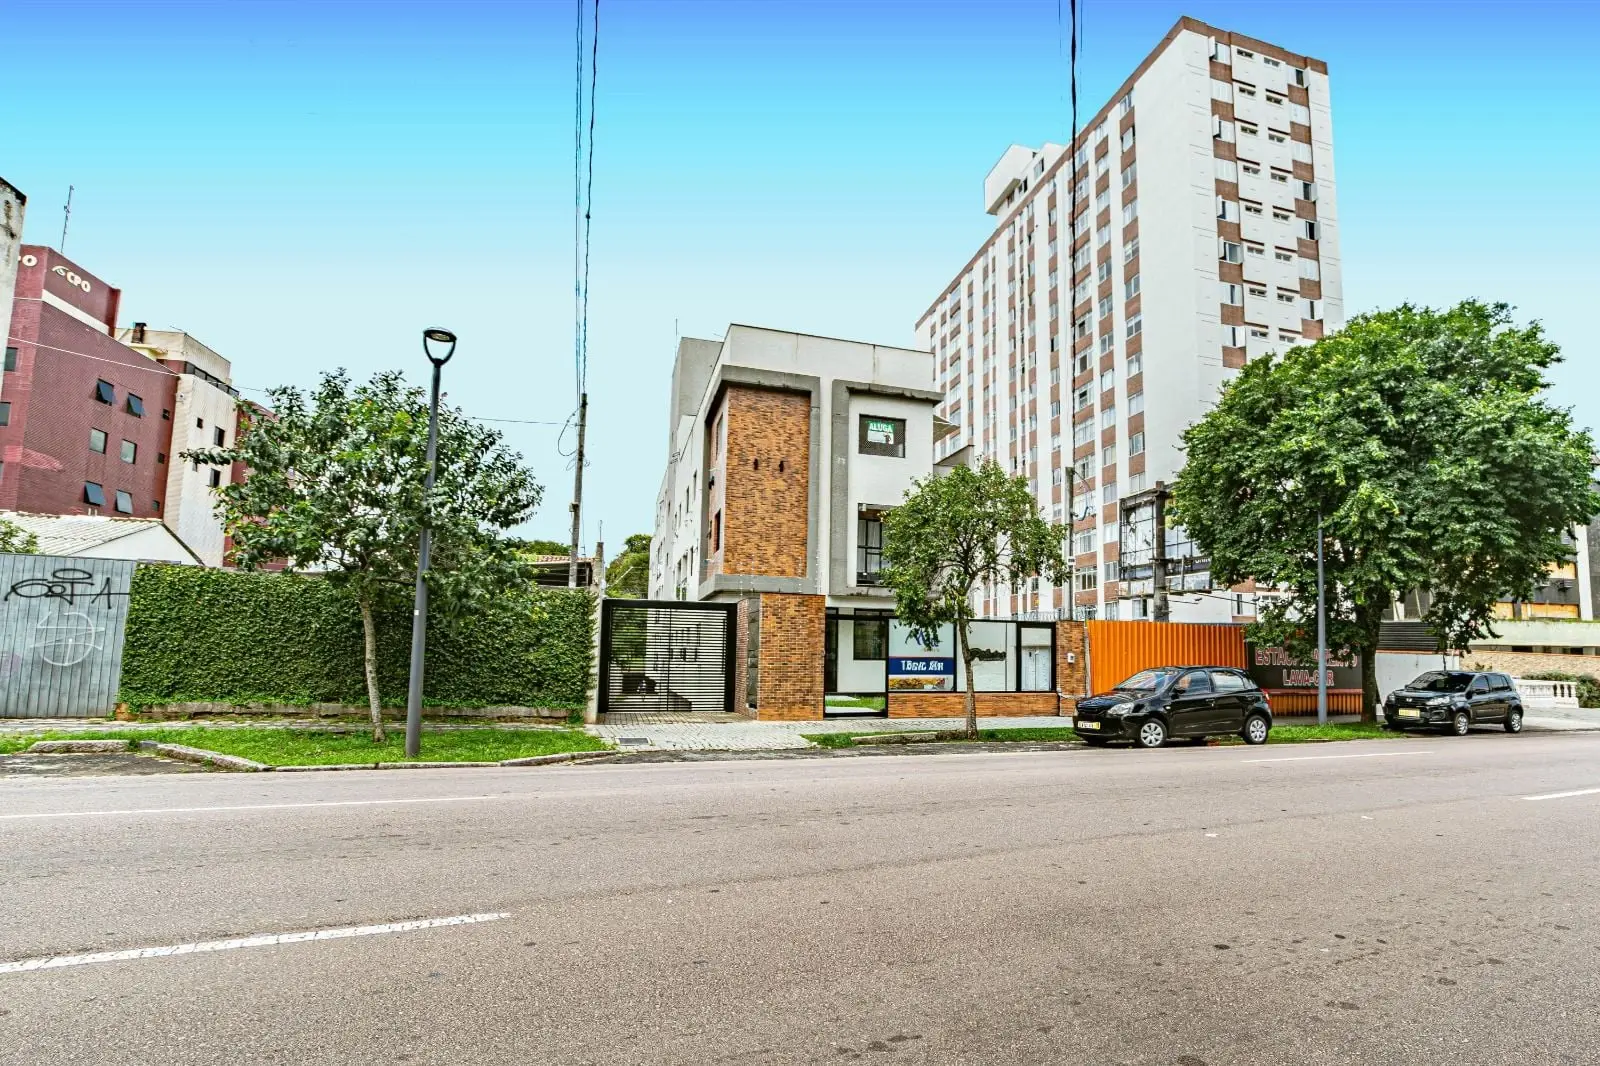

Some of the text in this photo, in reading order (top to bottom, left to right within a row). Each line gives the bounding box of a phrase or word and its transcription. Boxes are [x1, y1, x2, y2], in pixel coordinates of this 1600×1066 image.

[66, 271, 91, 293] CPO
[869, 422, 893, 433] ALUGA
[1282, 669, 1335, 687] LAVA-CR
